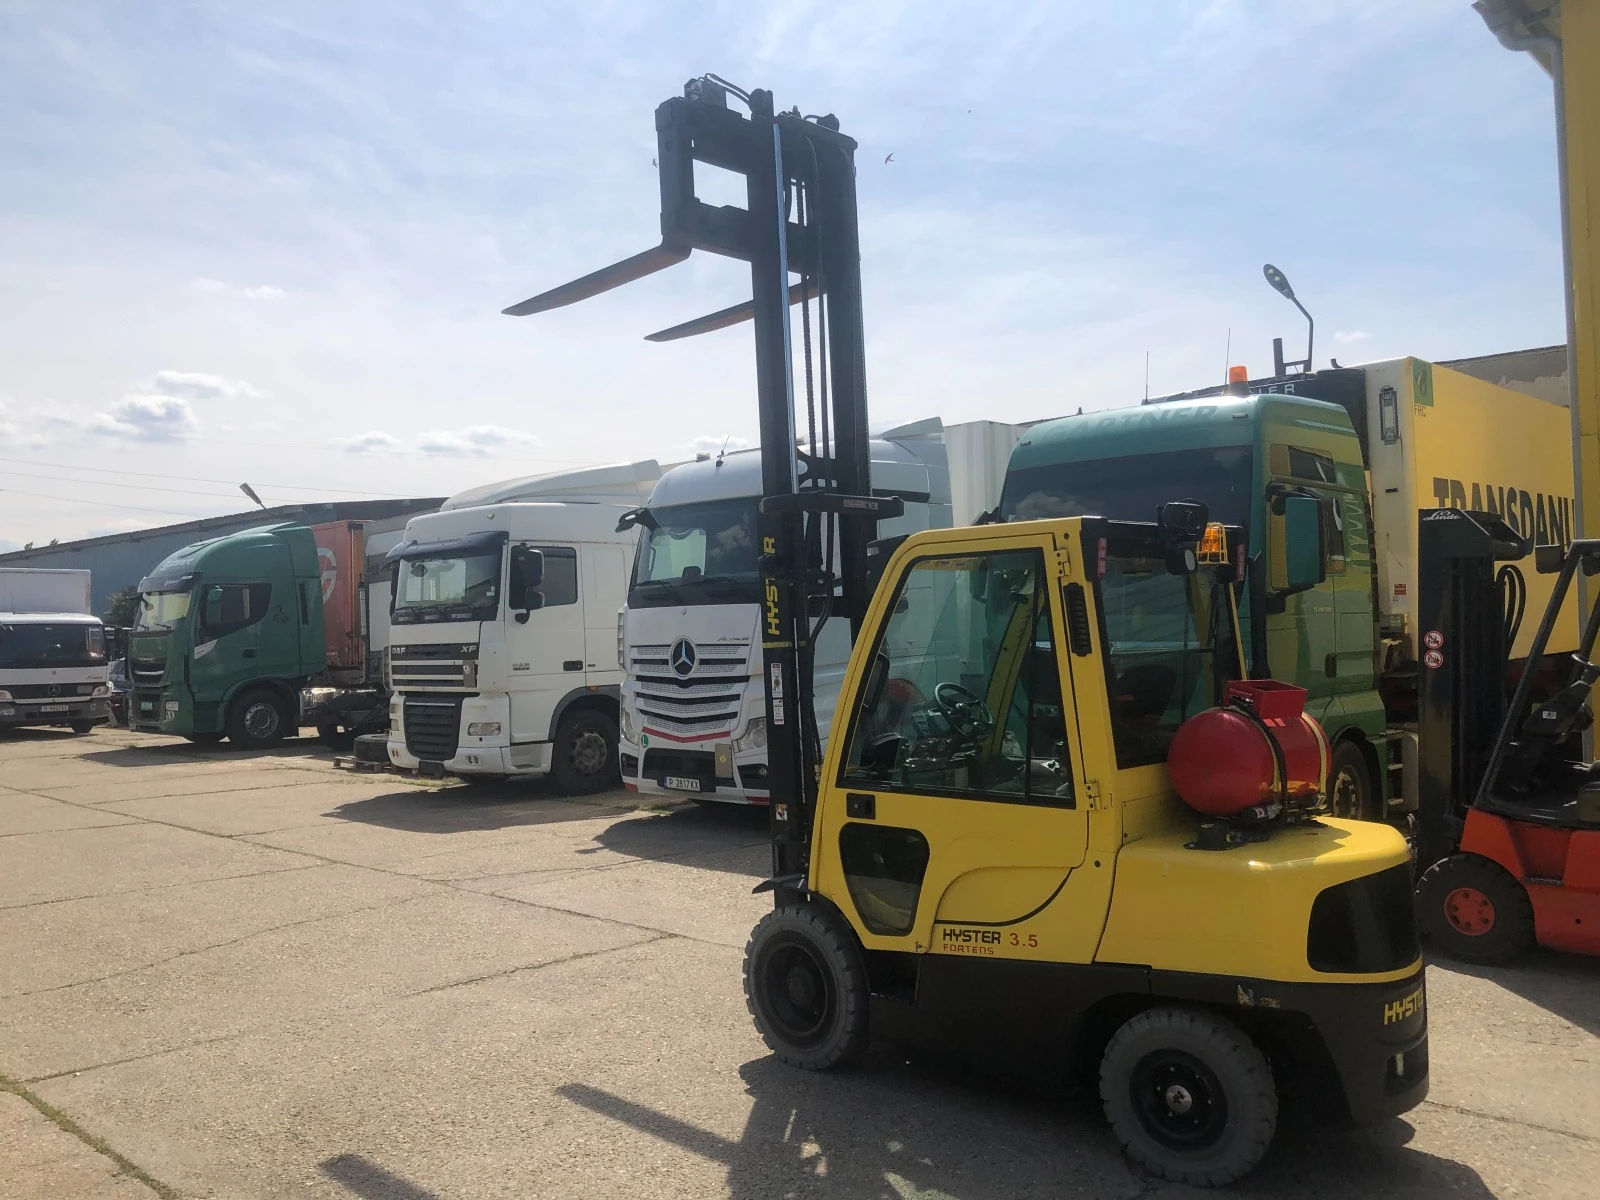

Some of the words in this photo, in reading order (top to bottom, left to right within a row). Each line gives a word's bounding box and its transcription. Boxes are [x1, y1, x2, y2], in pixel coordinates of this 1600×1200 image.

[1414, 404, 1426, 417] FRC
[1423, 510, 1462, 521] Linde
[763, 536, 780, 636] HYSR
[391, 646, 406, 654] DAF
[461, 645, 477, 653] XF
[943, 928, 1001, 944] HYSTER
[1009, 932, 1038, 948] 3.5
[943, 943, 994, 955] FORTENS
